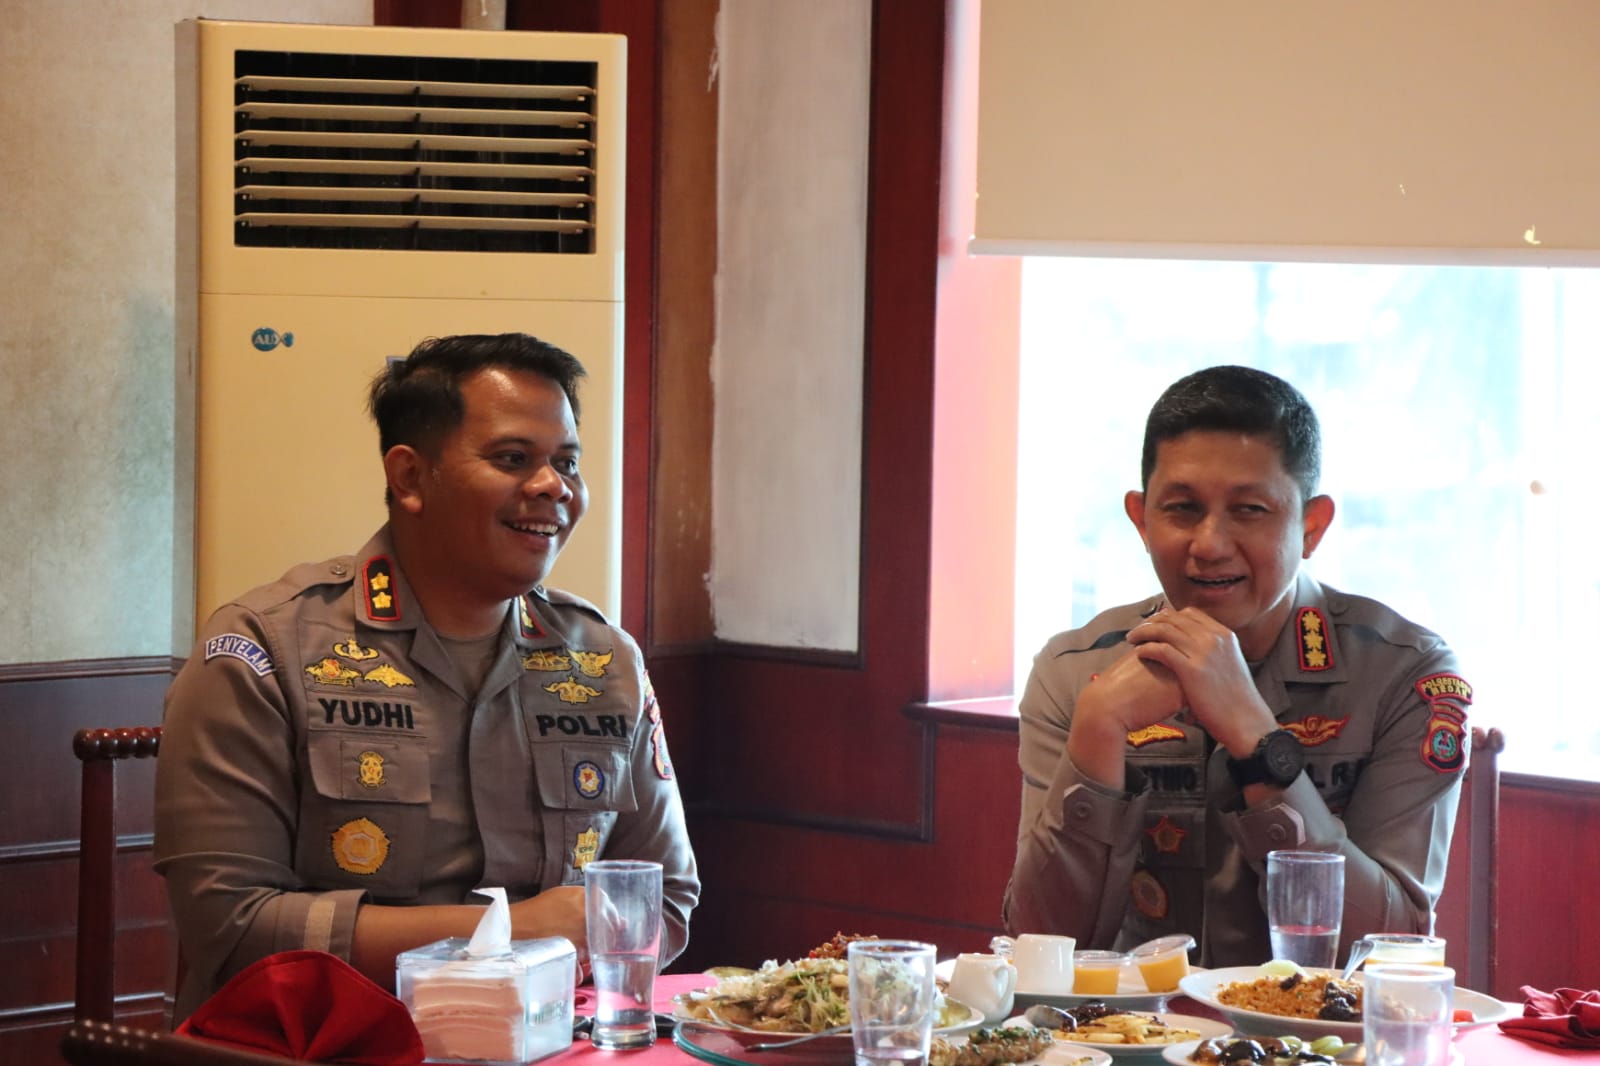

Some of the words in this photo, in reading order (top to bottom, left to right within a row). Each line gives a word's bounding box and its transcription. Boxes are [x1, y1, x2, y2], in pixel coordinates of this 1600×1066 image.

[209, 636, 272, 671] PENYELAM
[1431, 684, 1467, 698] MEDAN
[318, 698, 414, 729] YUDHI
[535, 714, 628, 738] POLRI
